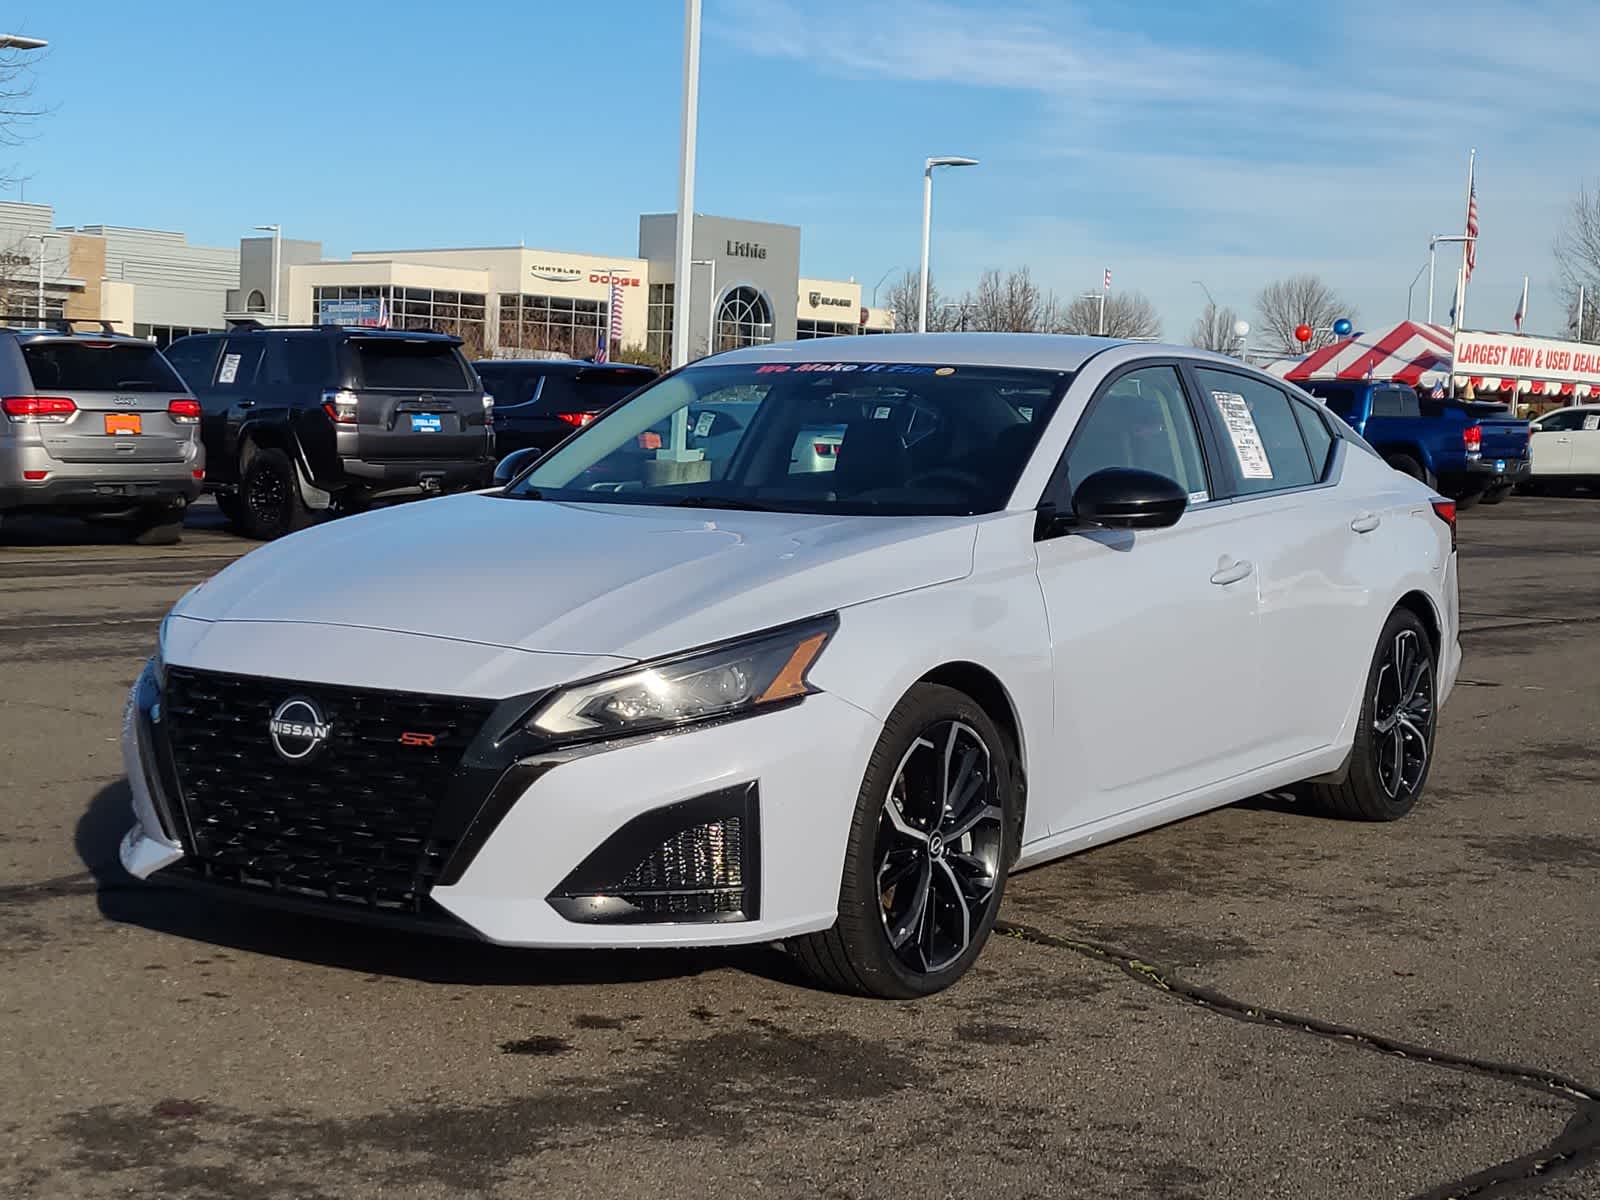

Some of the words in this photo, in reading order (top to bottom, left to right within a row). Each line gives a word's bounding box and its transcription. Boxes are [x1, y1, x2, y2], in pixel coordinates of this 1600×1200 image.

[726, 240, 766, 259] Lithia
[531, 264, 582, 275] CHRYSLER
[589, 273, 641, 288] DODGE
[1457, 343, 1507, 365] LARGEST
[1509, 346, 1533, 367] NEW
[1535, 349, 1543, 368] &
[1546, 350, 1571, 369] USED
[755, 365, 791, 374] We
[793, 363, 859, 373] Make
[862, 364, 886, 373] It
[269, 720, 327, 738] NISSAN
[402, 732, 436, 747] SR
